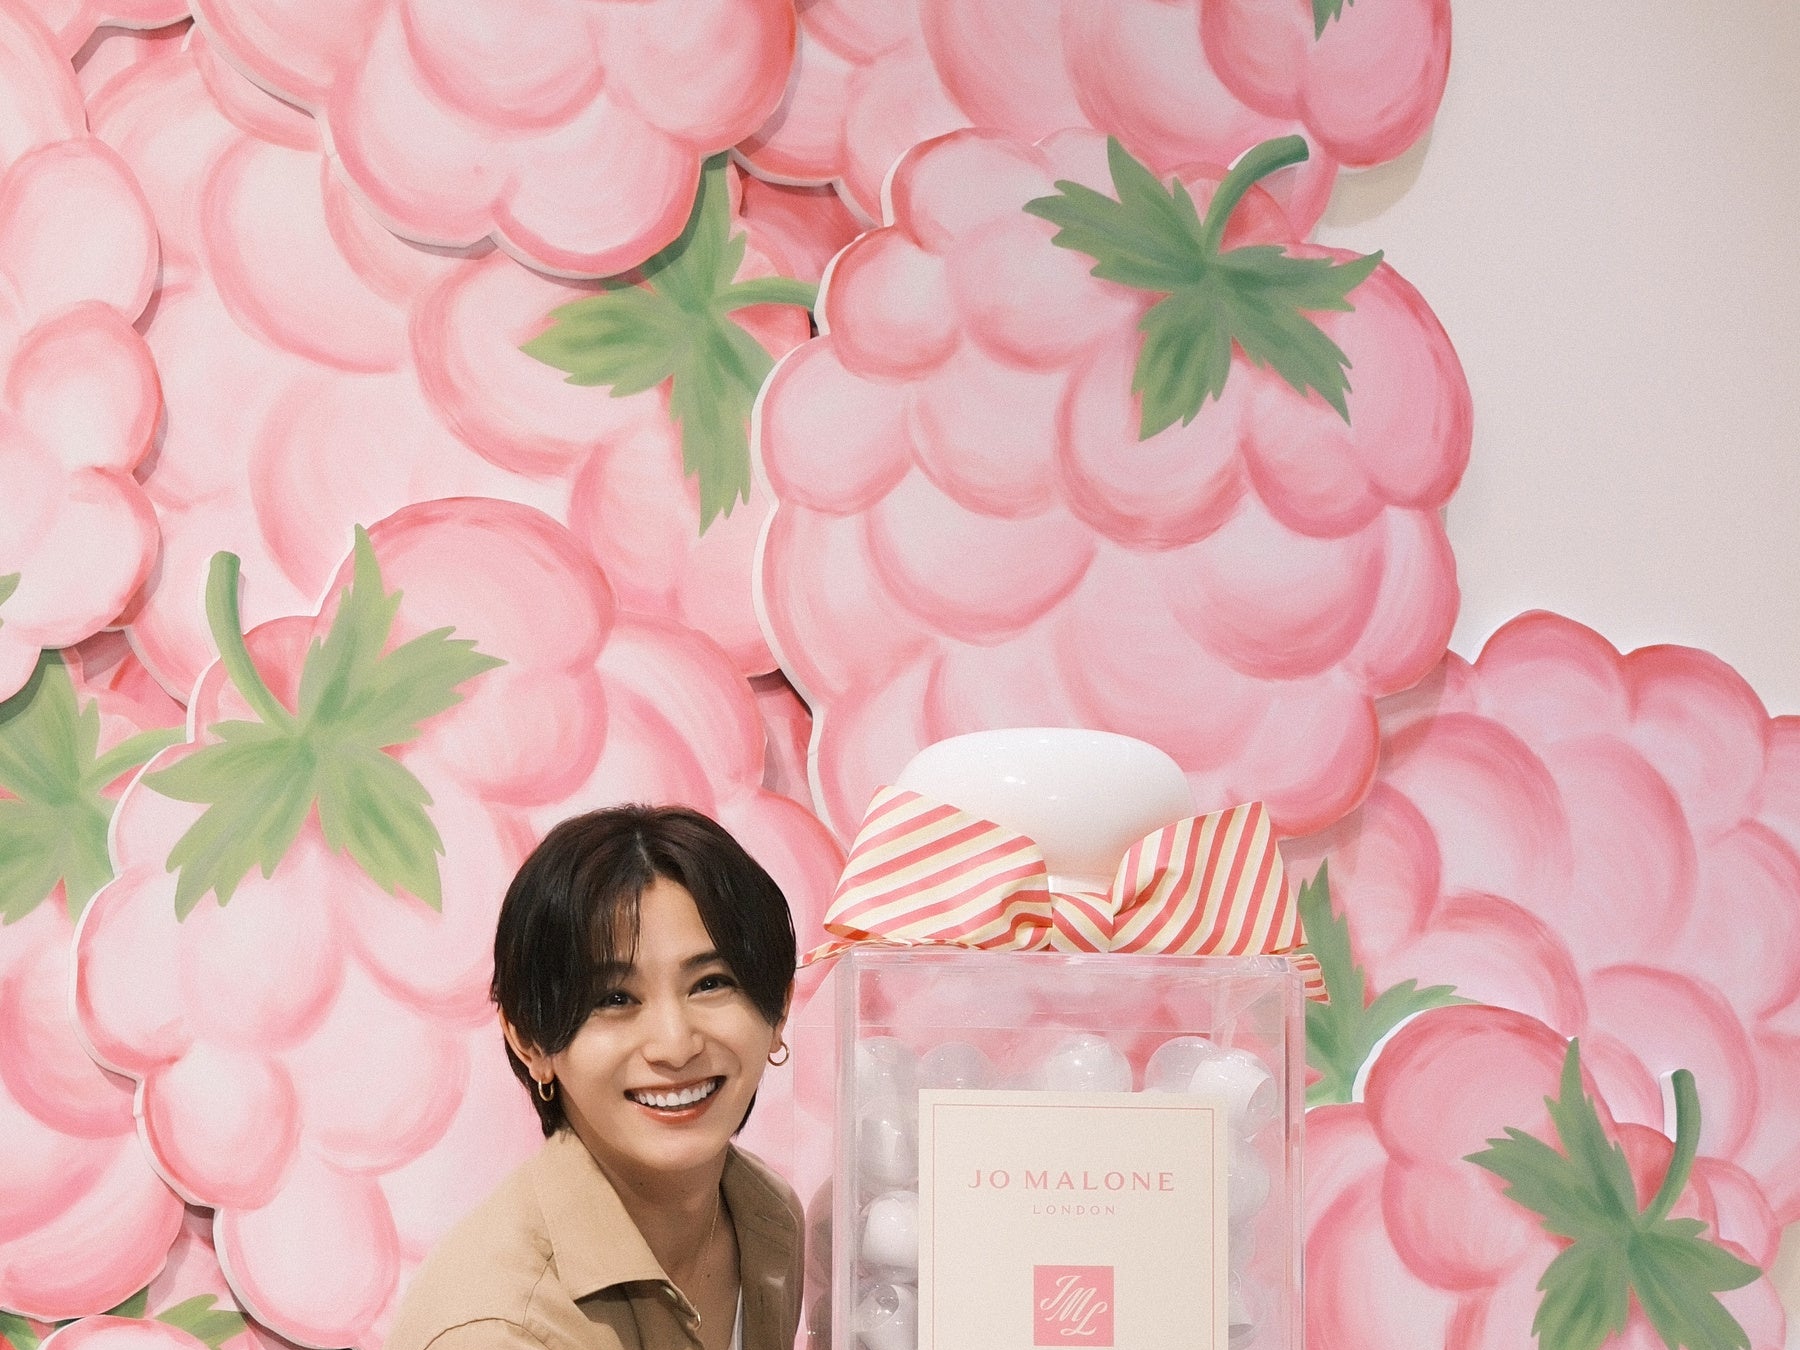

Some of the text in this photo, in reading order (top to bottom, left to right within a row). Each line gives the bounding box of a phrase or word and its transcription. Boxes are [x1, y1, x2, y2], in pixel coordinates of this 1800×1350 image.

[967, 1169, 1175, 1192] JO MALONE
[1032, 1204, 1117, 1217] LONDON
